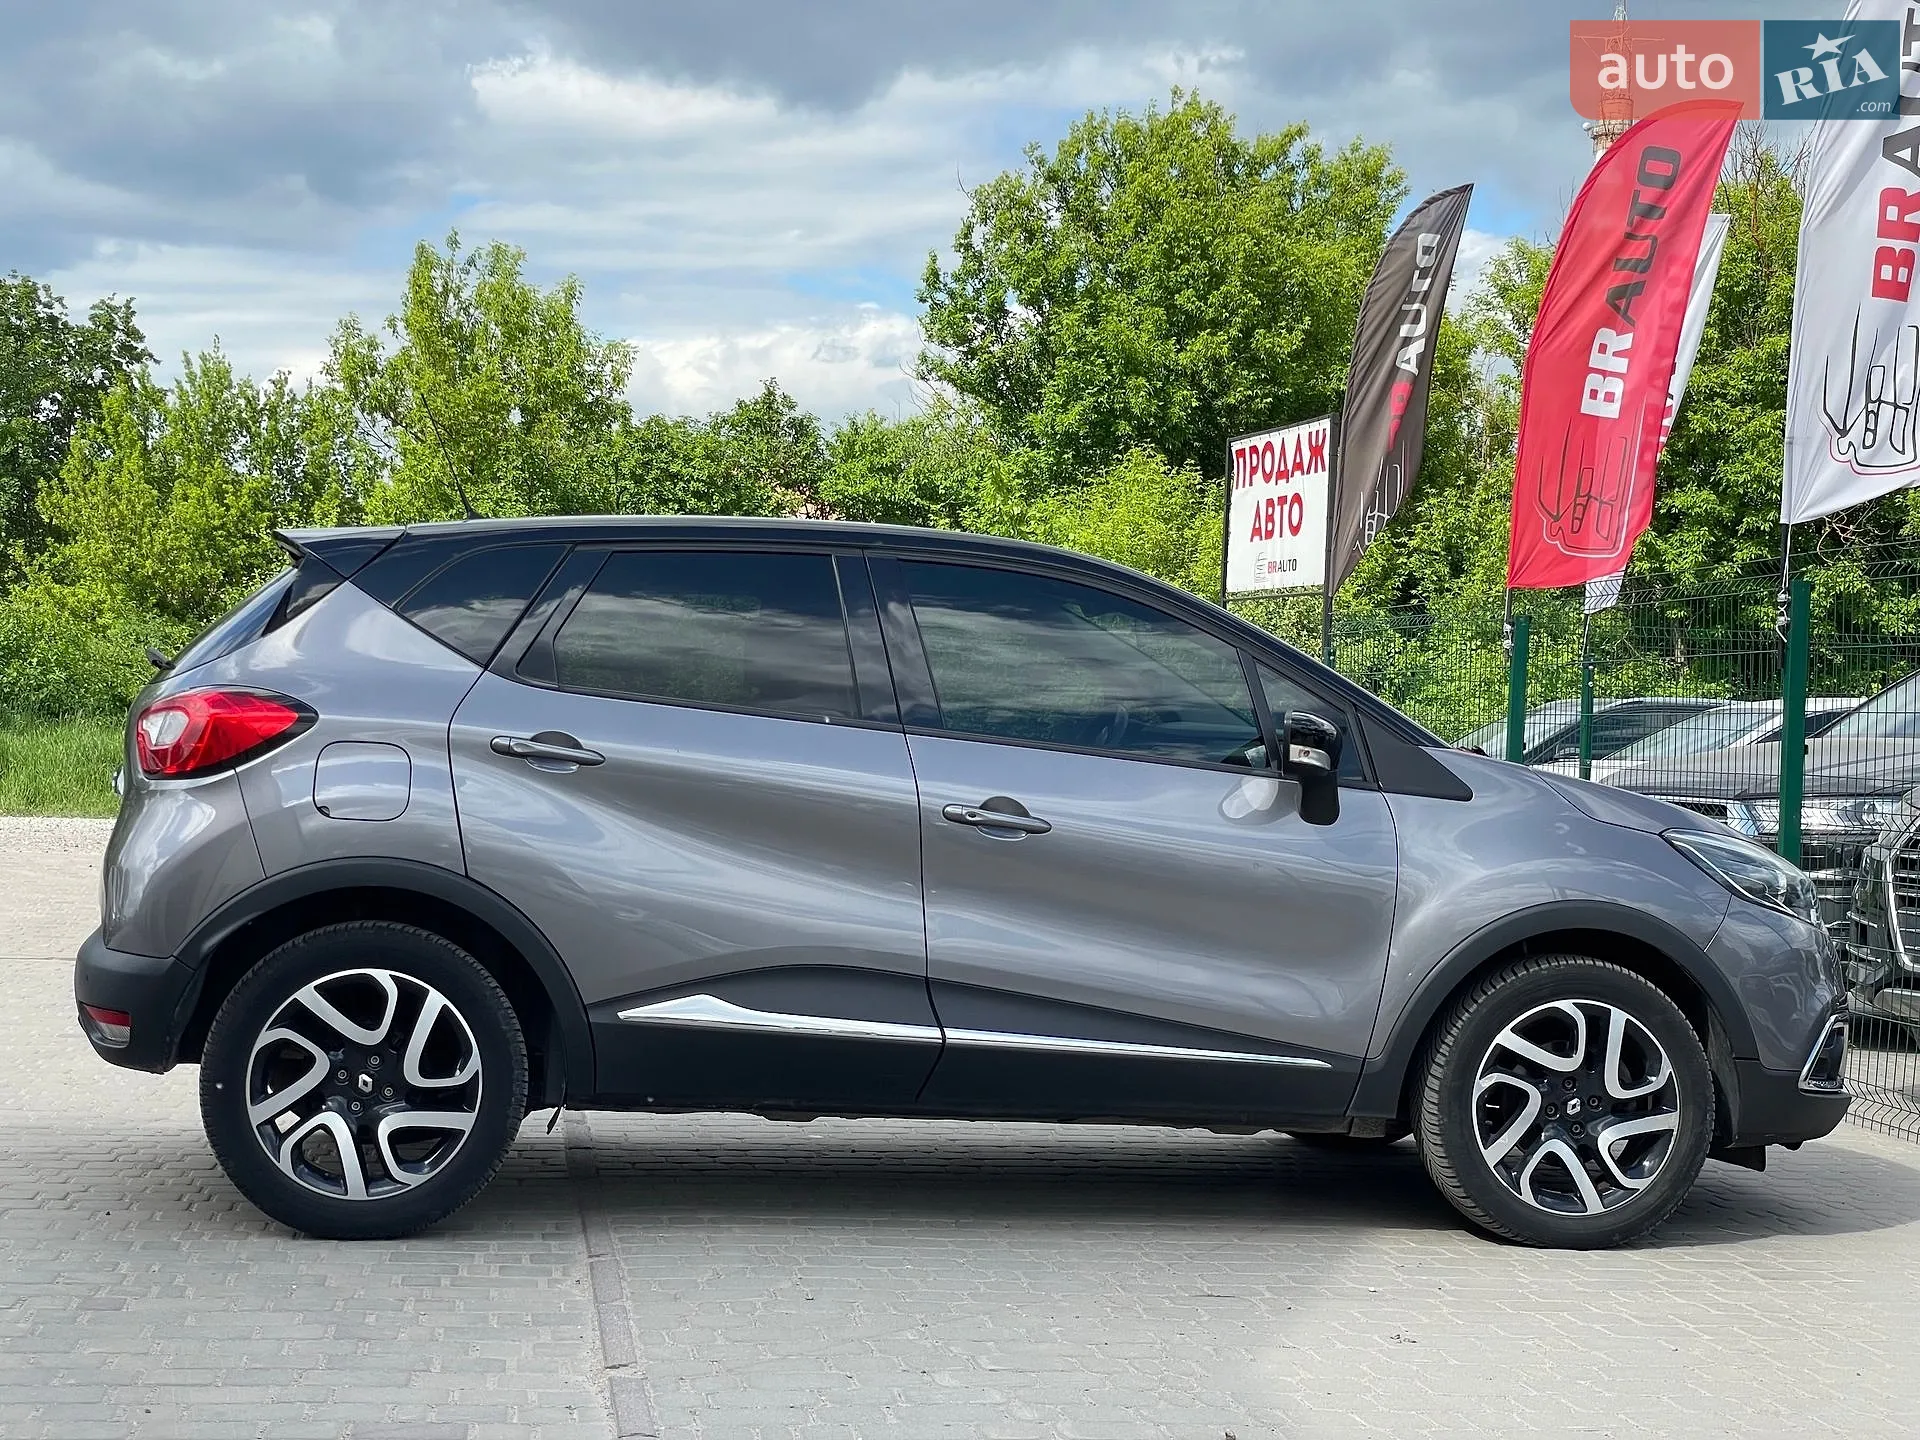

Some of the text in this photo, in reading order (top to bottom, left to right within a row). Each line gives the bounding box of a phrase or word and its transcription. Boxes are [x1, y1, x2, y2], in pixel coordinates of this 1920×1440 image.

[1580, 145, 1682, 419] BRAUTO
[1235, 428, 1326, 489] ПРОДАЖ
[1251, 492, 1303, 541] АВТО
[1267, 558, 1297, 573] BRAUTO
